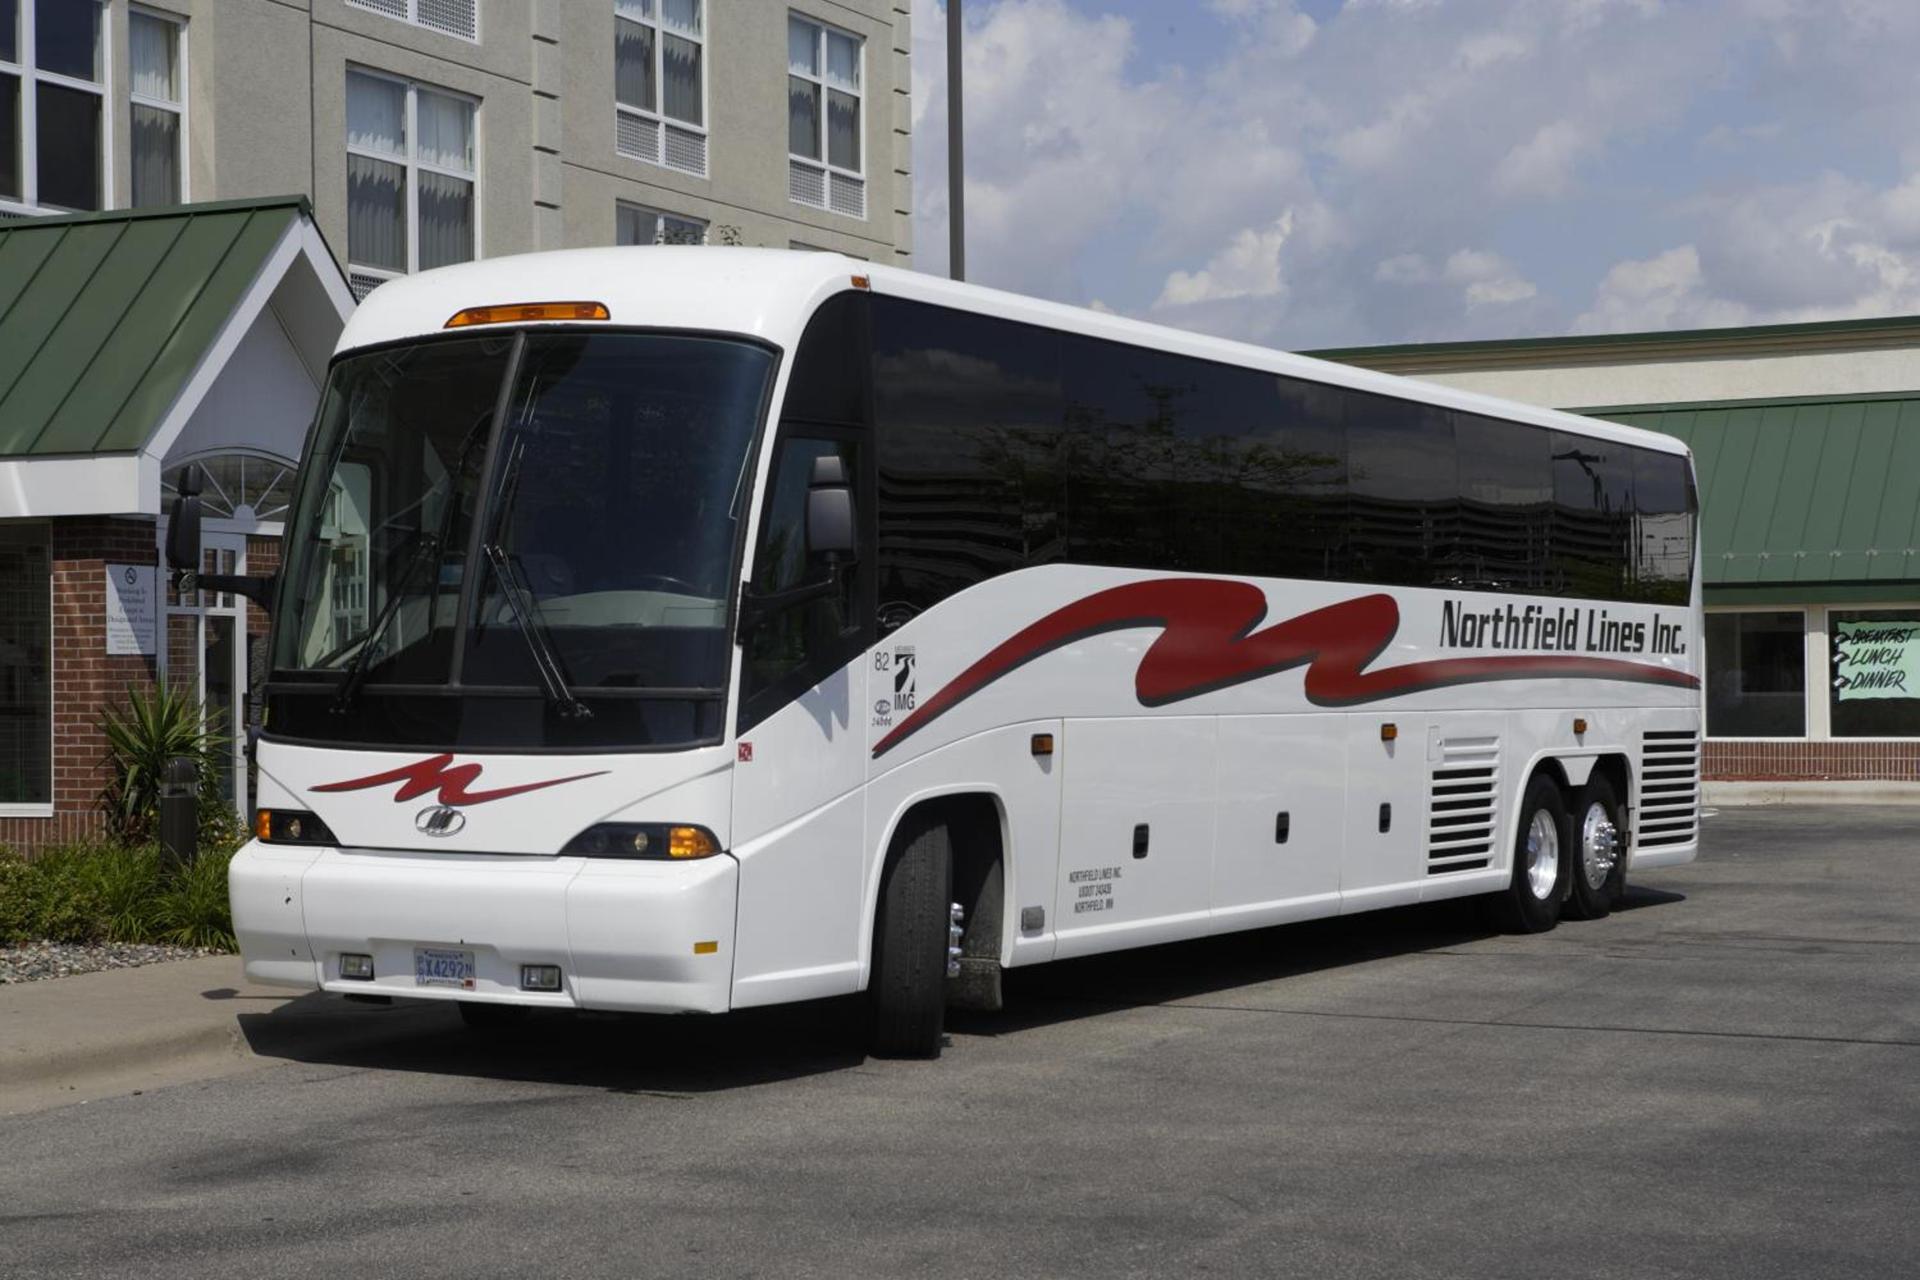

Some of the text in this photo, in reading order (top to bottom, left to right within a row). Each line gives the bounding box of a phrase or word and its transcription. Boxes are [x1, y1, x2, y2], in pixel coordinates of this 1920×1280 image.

[1440, 600, 1686, 655] Northfield Lines Inc.
[1850, 627, 1920, 645] BREAKFAST
[875, 651, 890, 671] 82
[1849, 647, 1904, 667] LUNCH
[1849, 669, 1907, 693] DINNER
[895, 693, 915, 711] IMG
